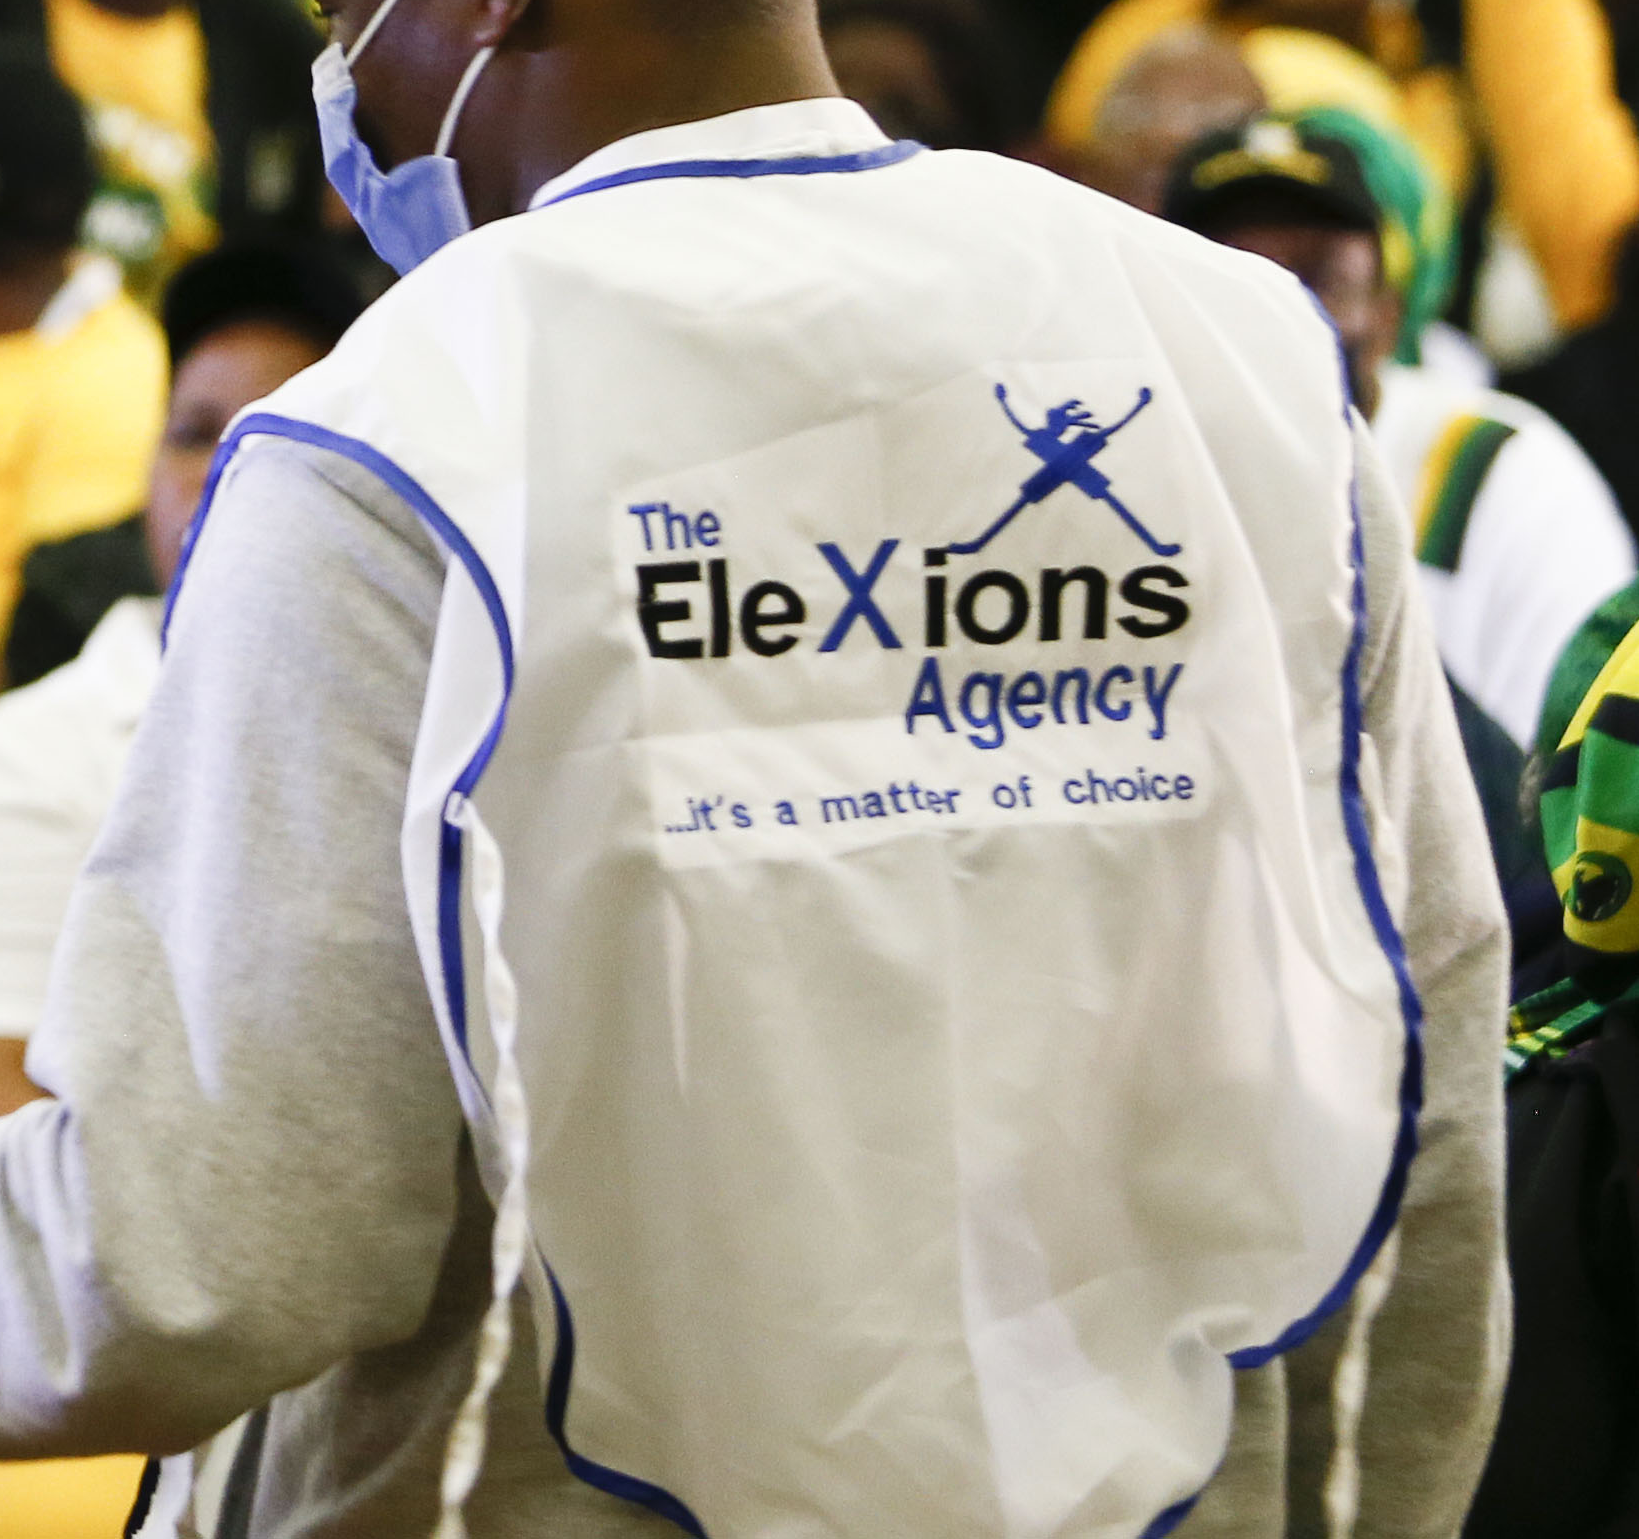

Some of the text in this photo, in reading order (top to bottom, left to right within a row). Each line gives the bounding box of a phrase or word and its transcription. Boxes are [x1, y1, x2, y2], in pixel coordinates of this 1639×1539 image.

[629, 503, 722, 551] The
[636, 538, 1191, 659] EleXions
[905, 657, 1184, 749] Agency
[775, 801, 799, 826] a
[821, 781, 961, 823] matter
[992, 775, 1033, 809] of
[1063, 766, 1196, 805] choice
